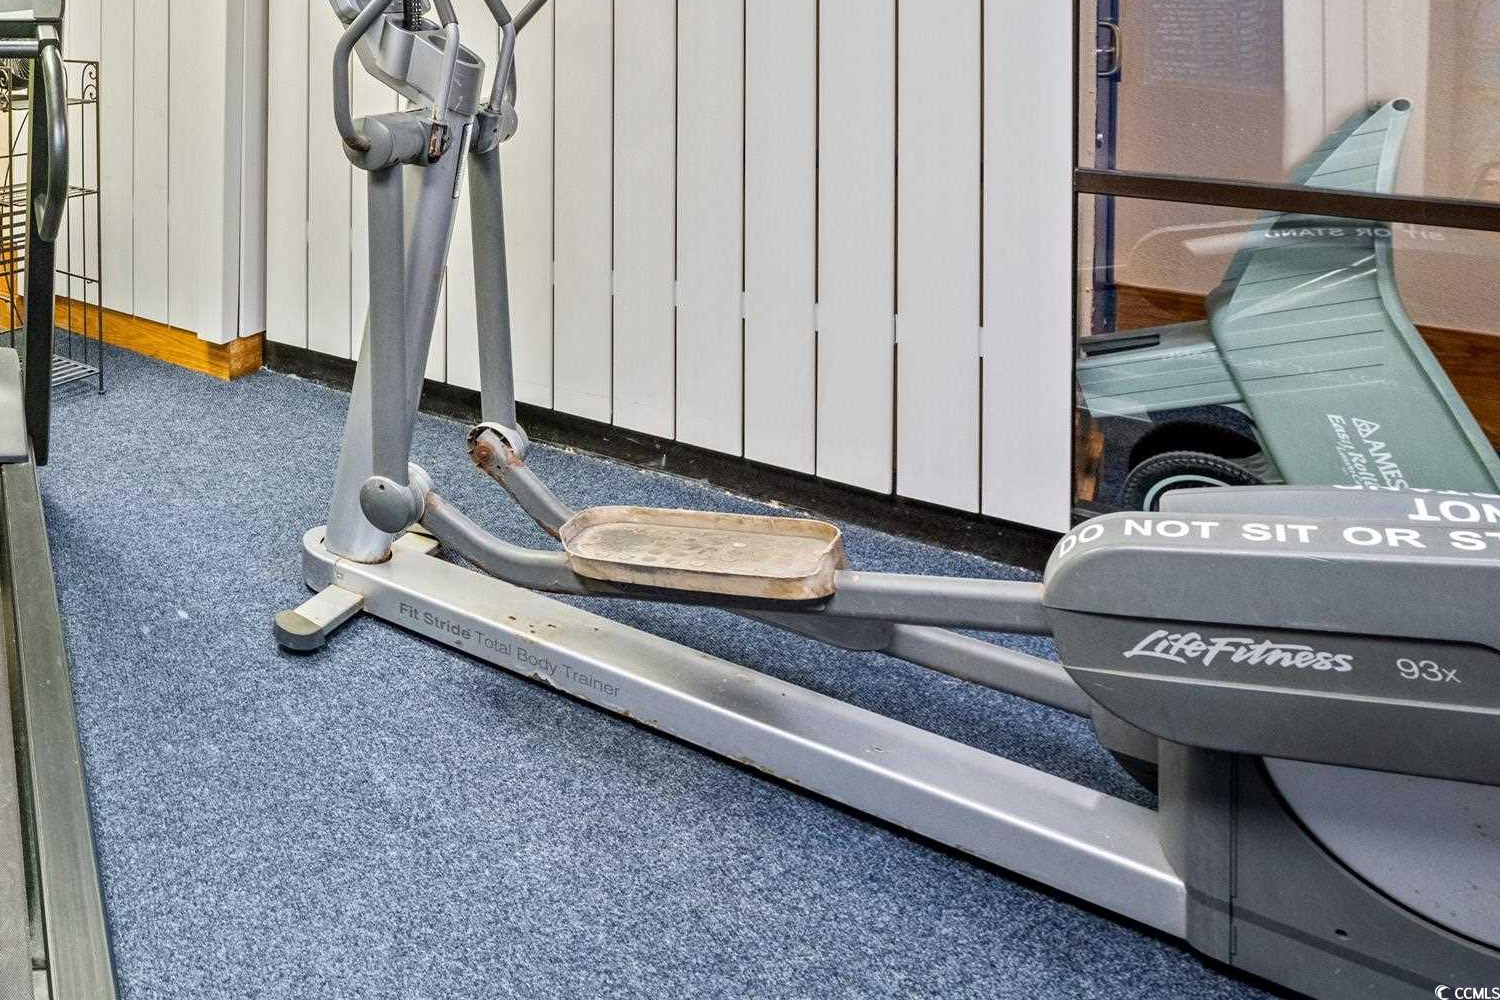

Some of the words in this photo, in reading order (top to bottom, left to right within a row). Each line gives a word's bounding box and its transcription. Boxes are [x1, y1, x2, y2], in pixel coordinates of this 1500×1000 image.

[1059, 523, 1105, 558] DO
[1123, 518, 1220, 540] NOT
[1241, 522, 1319, 544] SIT
[1342, 526, 1427, 549] OR
[399, 602, 421, 621] Fit
[423, 611, 471, 640] Stride
[474, 630, 512, 656] Total
[517, 647, 557, 677] Body
[562, 663, 621, 697] Trainer
[1396, 658, 1462, 684] 93x
